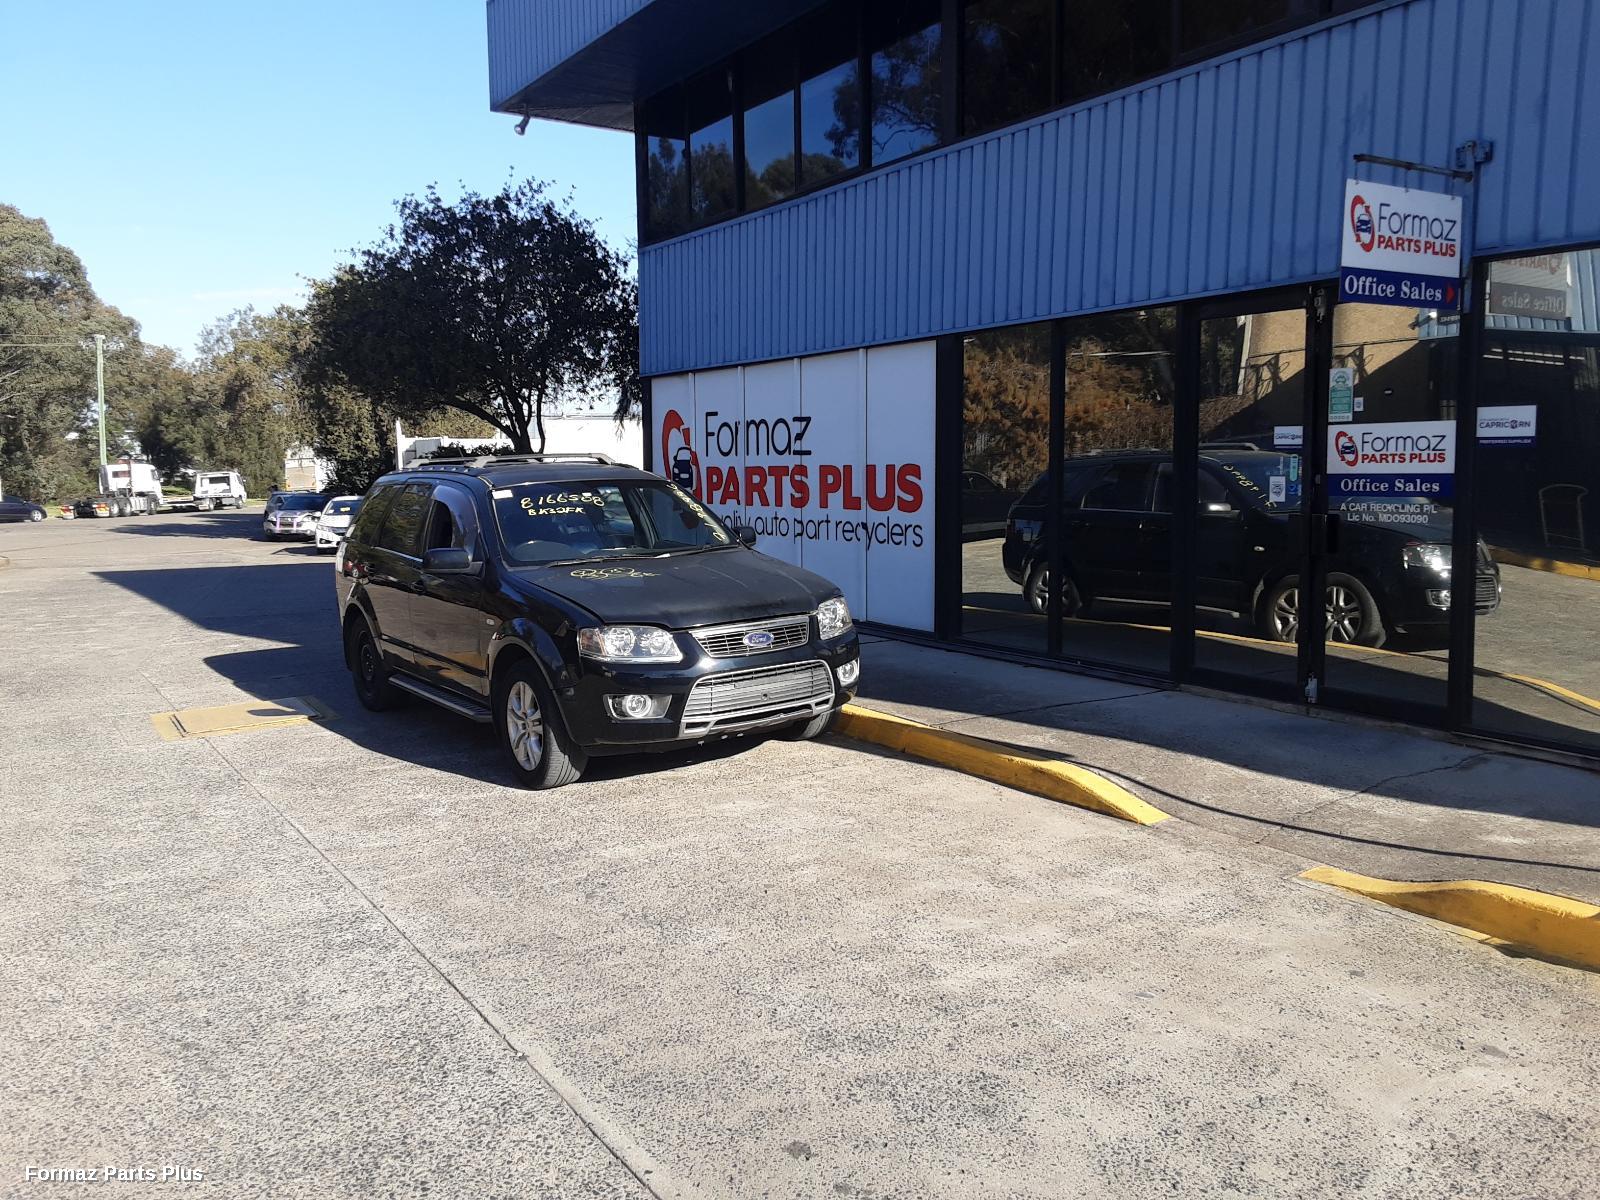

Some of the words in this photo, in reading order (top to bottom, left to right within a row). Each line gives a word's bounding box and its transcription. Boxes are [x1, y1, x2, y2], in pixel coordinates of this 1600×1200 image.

[1378, 203, 1457, 242] Formaz
[1377, 234, 1422, 253] PARTS
[1424, 240, 1456, 257] PLUS
[1345, 274, 1396, 297] Office
[1400, 280, 1442, 301] Sales
[705, 411, 813, 457] Formaz
[1361, 432, 1446, 453] Formaz
[1361, 453, 1406, 464] PARTS
[1409, 452, 1446, 464] PLUS
[706, 463, 811, 509] PARTS
[819, 463, 924, 513] PLUS
[1340, 478, 1390, 492] Office
[1395, 478, 1440, 493] Sales
[1340, 503, 1348, 511] A
[1349, 503, 1368, 512] CAR
[1370, 503, 1421, 513] RECYCLING
[1347, 513, 1360, 522] Lic
[1362, 513, 1377, 522] No.
[755, 511, 790, 537] auto
[793, 514, 831, 545] part
[835, 515, 924, 551] recyclers
